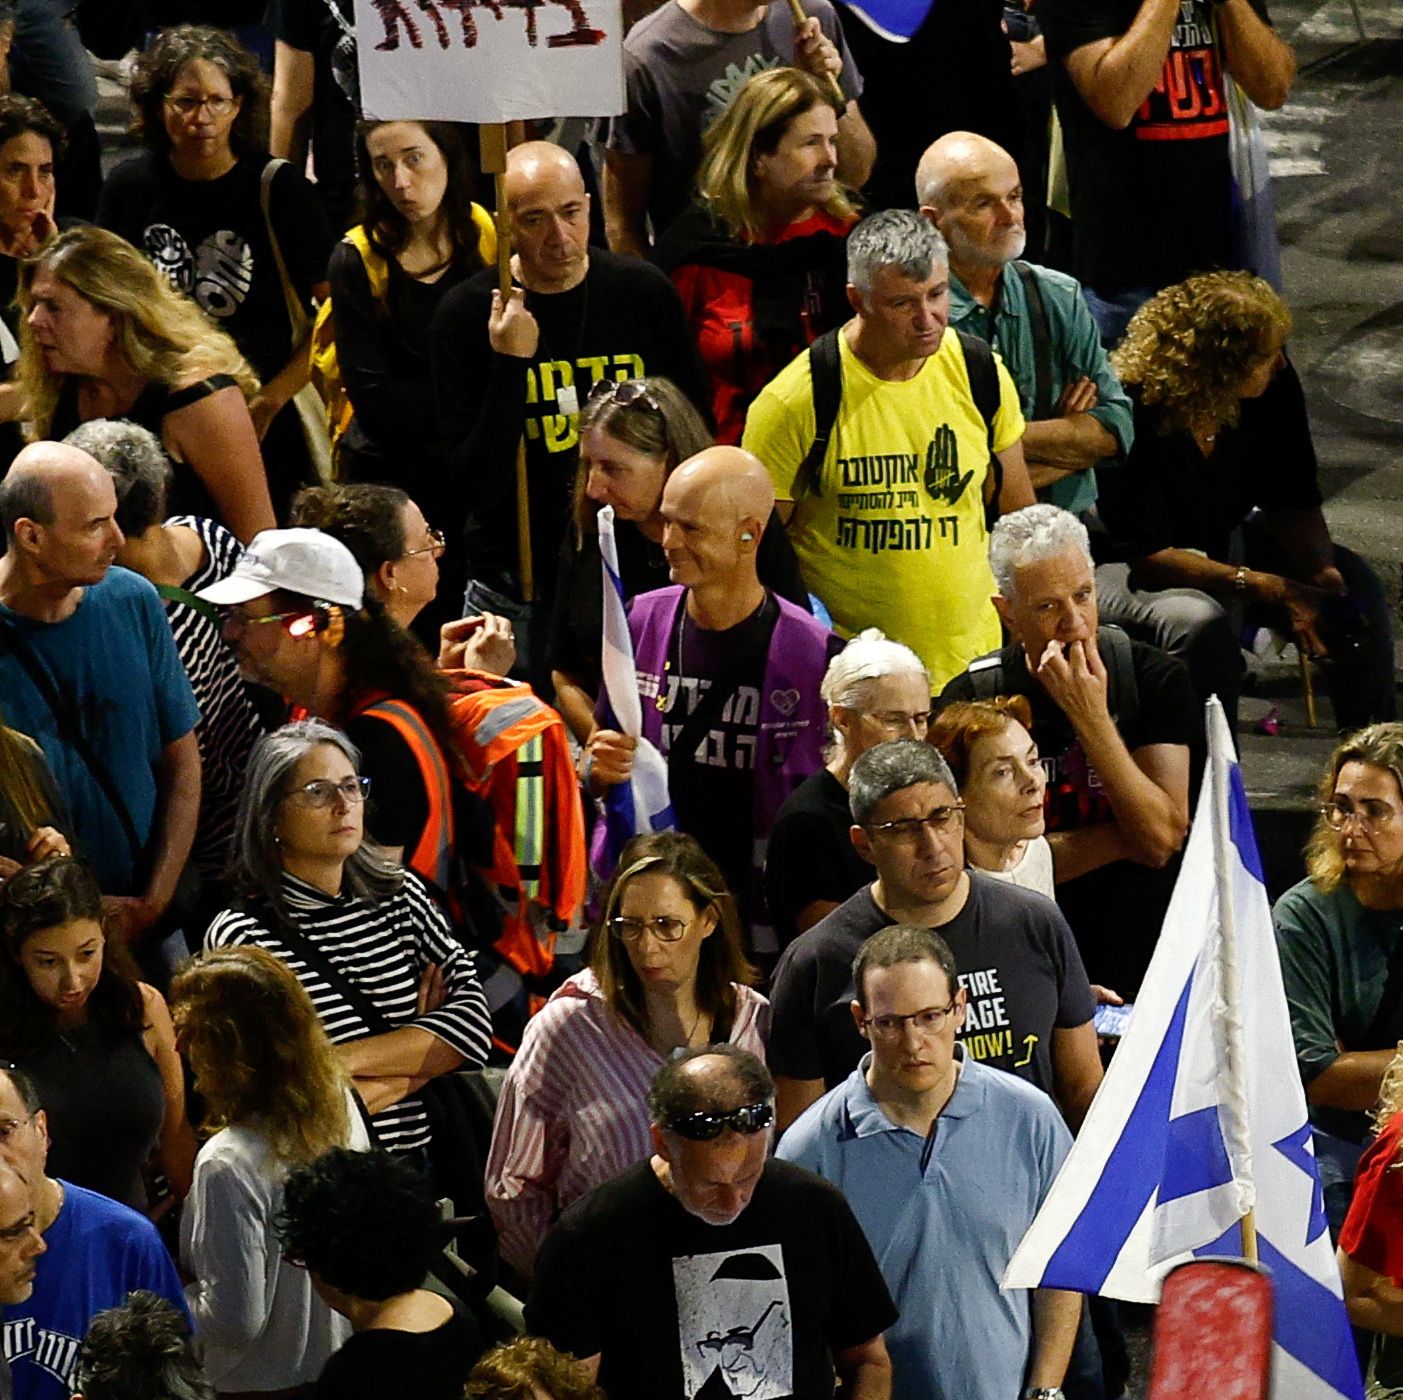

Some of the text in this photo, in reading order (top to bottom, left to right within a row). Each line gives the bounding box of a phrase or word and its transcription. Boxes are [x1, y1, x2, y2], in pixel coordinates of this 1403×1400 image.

[838, 454, 919, 490] אוקטובר
[837, 514, 960, 555] די להפקרה!
